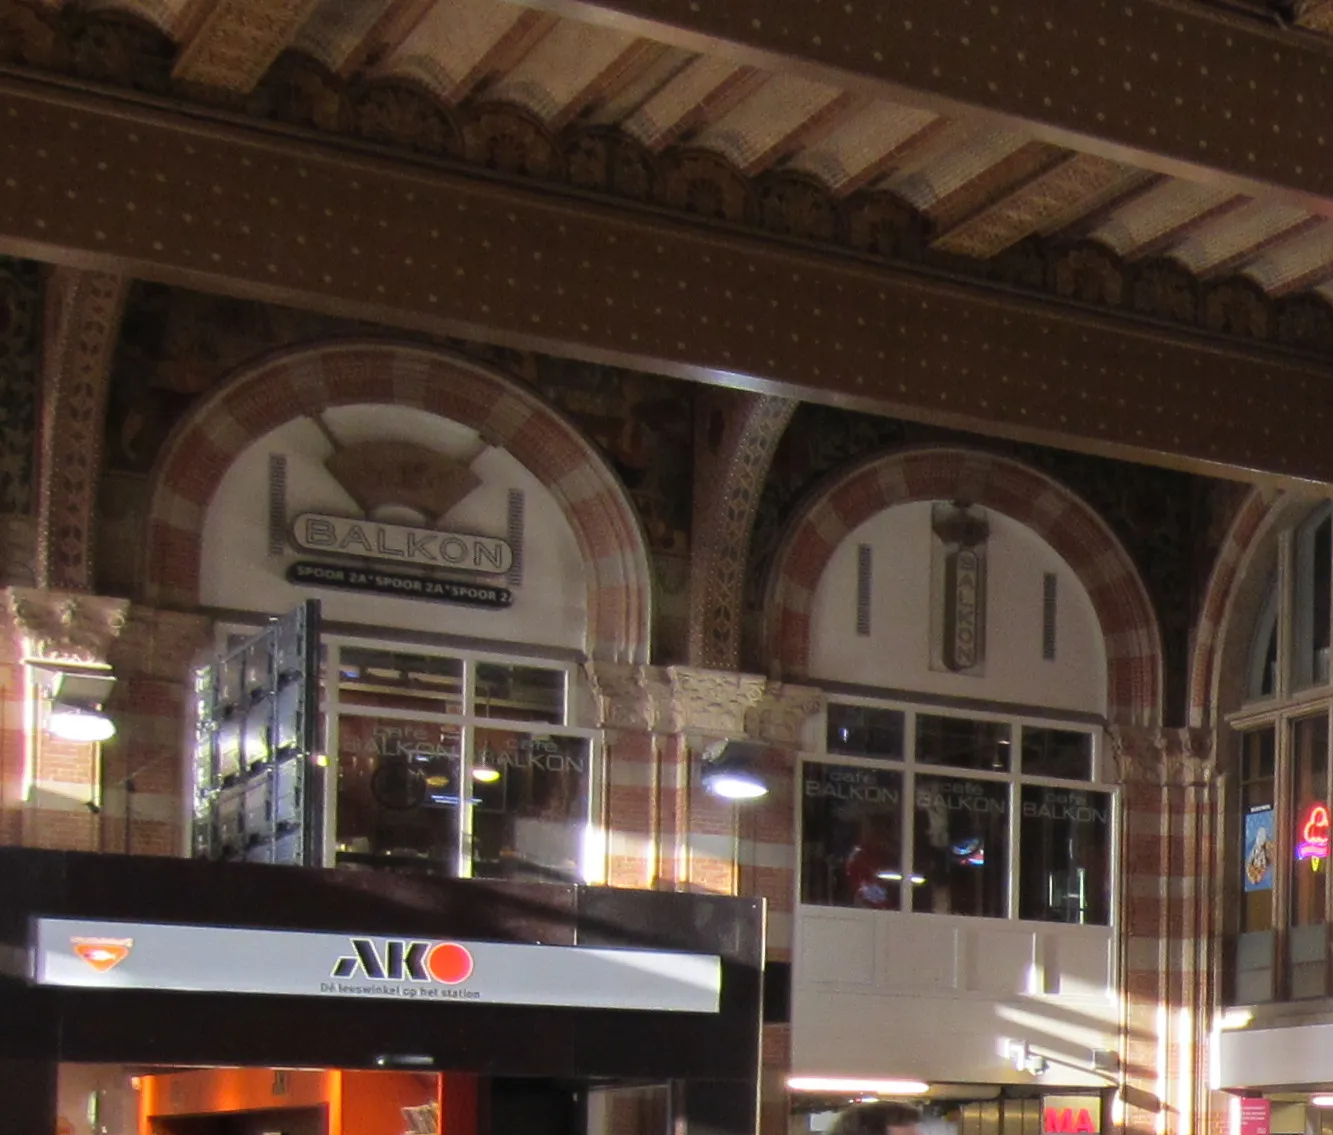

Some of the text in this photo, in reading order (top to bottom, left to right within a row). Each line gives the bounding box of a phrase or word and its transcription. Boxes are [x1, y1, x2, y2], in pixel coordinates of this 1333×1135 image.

[305, 518, 503, 569] BALKON
[296, 566, 345, 581] SPOOR
[805, 780, 899, 805] BALKON
[916, 792, 1006, 815] BALKON
[1023, 802, 1110, 825] BALKON
[330, 937, 474, 985] AKO
